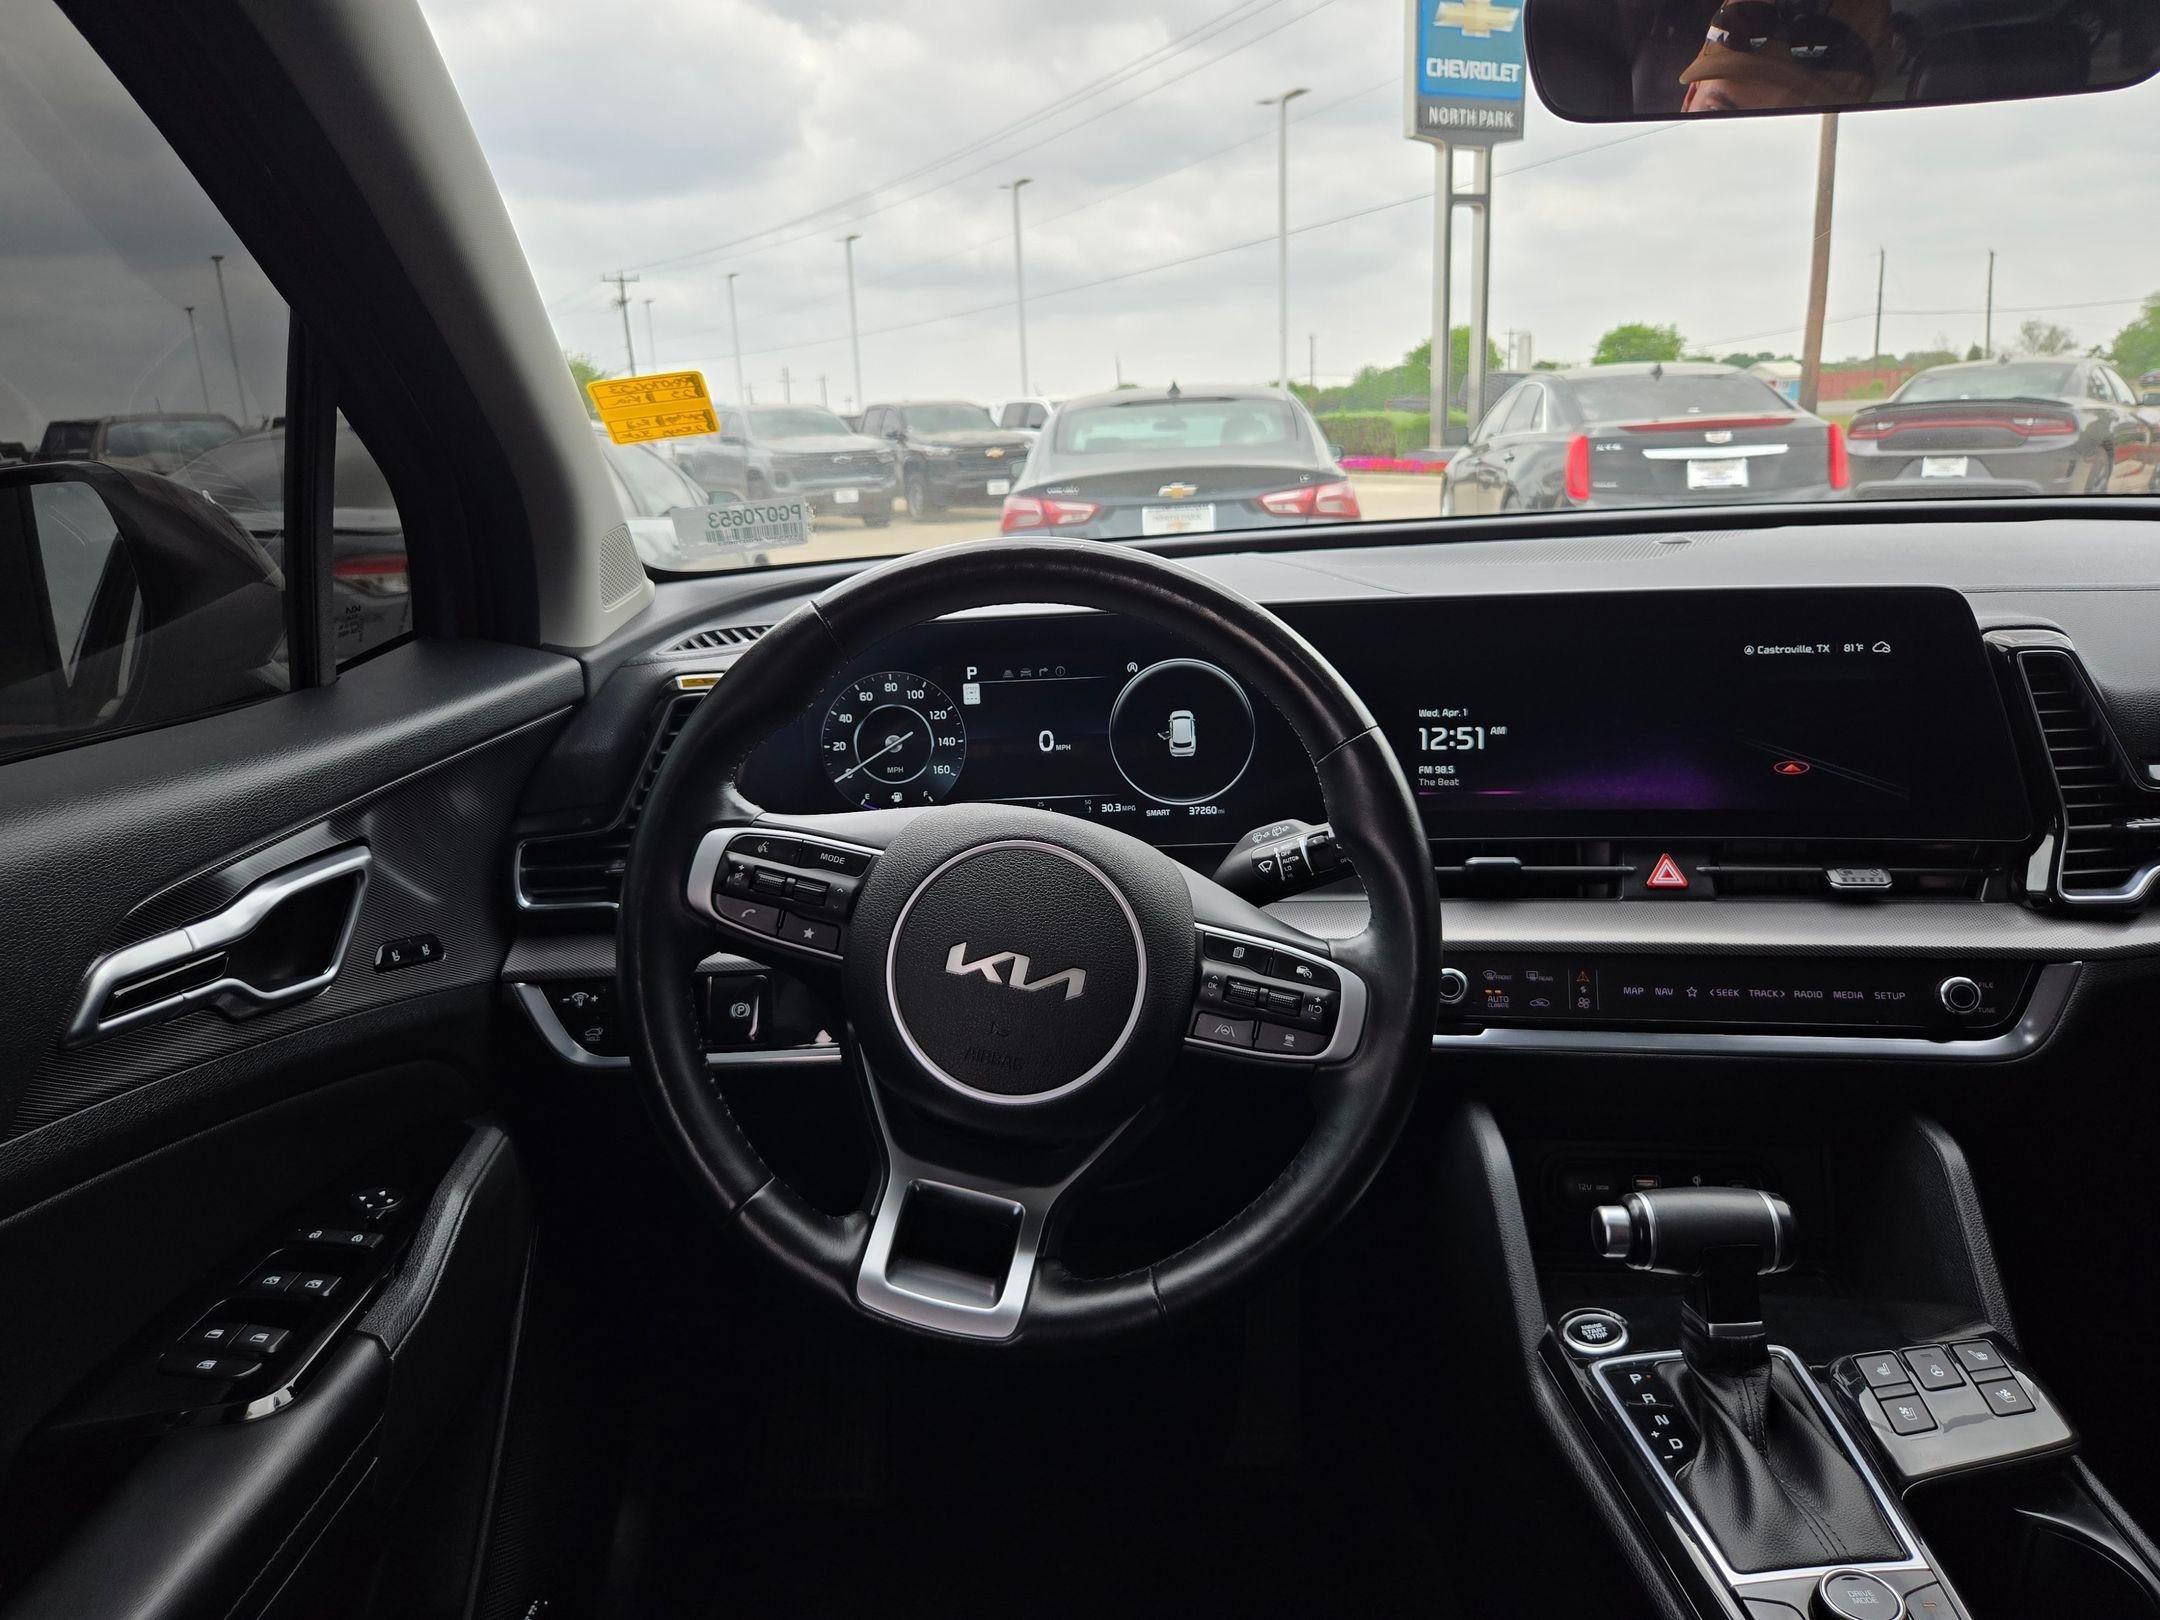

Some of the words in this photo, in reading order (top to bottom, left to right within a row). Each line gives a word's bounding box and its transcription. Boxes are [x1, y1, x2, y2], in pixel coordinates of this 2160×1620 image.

[1426, 58, 1521, 82] CHEVROLET
[1429, 106, 1476, 126] NORTH
[1479, 110, 1514, 128] PARK
[1757, 645, 1814, 654] Castroville,
[1816, 644, 1831, 653] TX
[966, 666, 978, 680] P
[884, 682, 898, 692] 80
[859, 691, 874, 701] 60
[907, 690, 925, 700] 100
[838, 713, 853, 723] 40
[929, 710, 947, 720] 120
[1442, 708, 1461, 719] Apr.
[1463, 708, 1468, 717] 1
[938, 736, 956, 746] 140
[1038, 730, 1055, 752] 0
[1418, 726, 1485, 751] 12:51
[1490, 726, 1507, 735] AM
[832, 741, 846, 751] 20
[933, 765, 950, 775] 160
[1418, 765, 1433, 774] FM
[1434, 765, 1455, 774] 98.5
[1418, 778, 1435, 786] The
[1438, 778, 1459, 786] Beat
[1101, 803, 1121, 813] 30.3
[1145, 809, 1170, 817] SMART
[1188, 806, 1217, 816] 37260
[820, 852, 846, 865] MODE
[945, 941, 1087, 1001] KIA
[1207, 982, 1217, 990] OK
[1623, 986, 1644, 995] MAP
[1655, 987, 1673, 996] NAV
[1716, 988, 1740, 997] SEEK
[1749, 989, 1779, 998] TRACK
[1793, 990, 1823, 999] RADIO
[1833, 990, 1864, 1000] MEDIA
[1874, 991, 1906, 1000] SETUP
[1581, 1326, 1607, 1336] START
[1586, 1331, 1608, 1340] STOP
[1629, 1373, 1642, 1384] P
[1642, 1393, 1656, 1404] R
[1654, 1414, 1670, 1426] N
[1668, 1438, 1684, 1450] D
[1847, 1589, 1876, 1598] DRIVE
[1851, 1597, 1880, 1605] MODE
